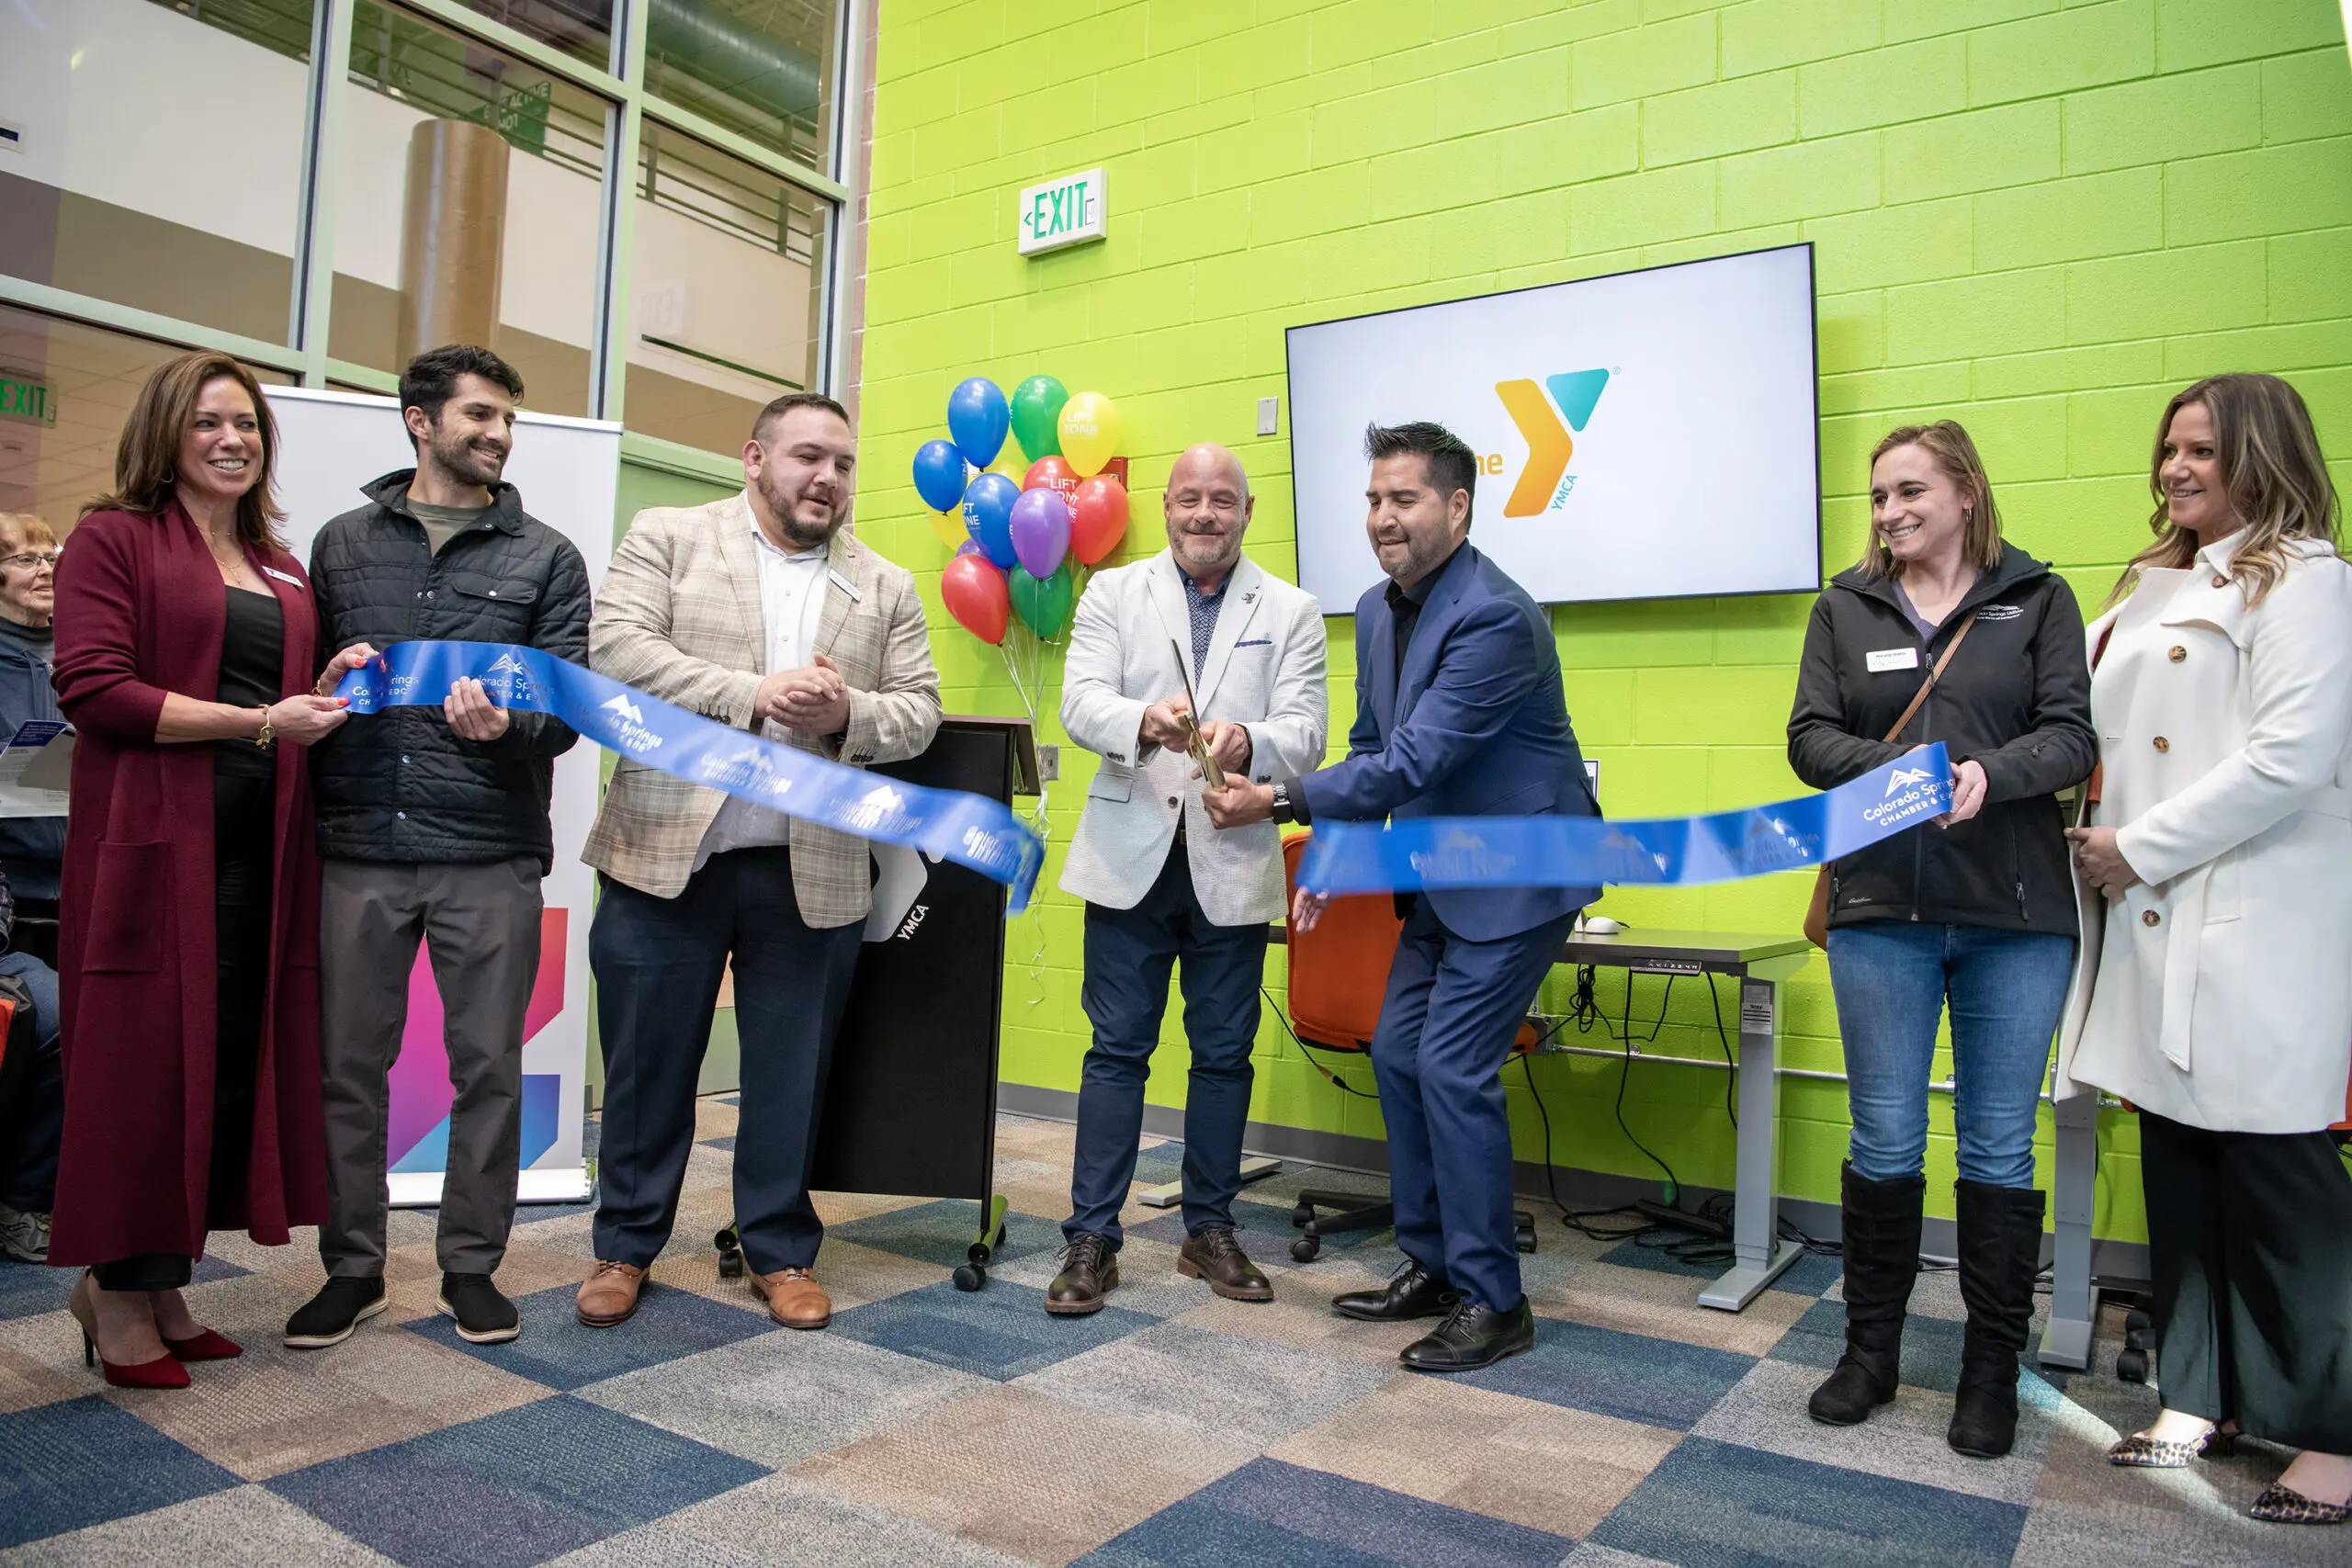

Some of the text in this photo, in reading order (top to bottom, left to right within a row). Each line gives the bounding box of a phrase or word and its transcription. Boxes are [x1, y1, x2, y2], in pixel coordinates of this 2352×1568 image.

[1035, 181, 1088, 240] EXIT
[0, 379, 48, 419] EXIT
[1063, 423, 1097, 436] ZONE
[1067, 412, 1093, 423] LIFT
[1050, 478, 1077, 490] LIFT
[1551, 474, 1577, 510] YMCA
[1863, 791, 1920, 820] Colorado
[1880, 801, 1929, 826] CHAMBER
[1930, 796, 1938, 805] &
[897, 904, 929, 941] YMCA
